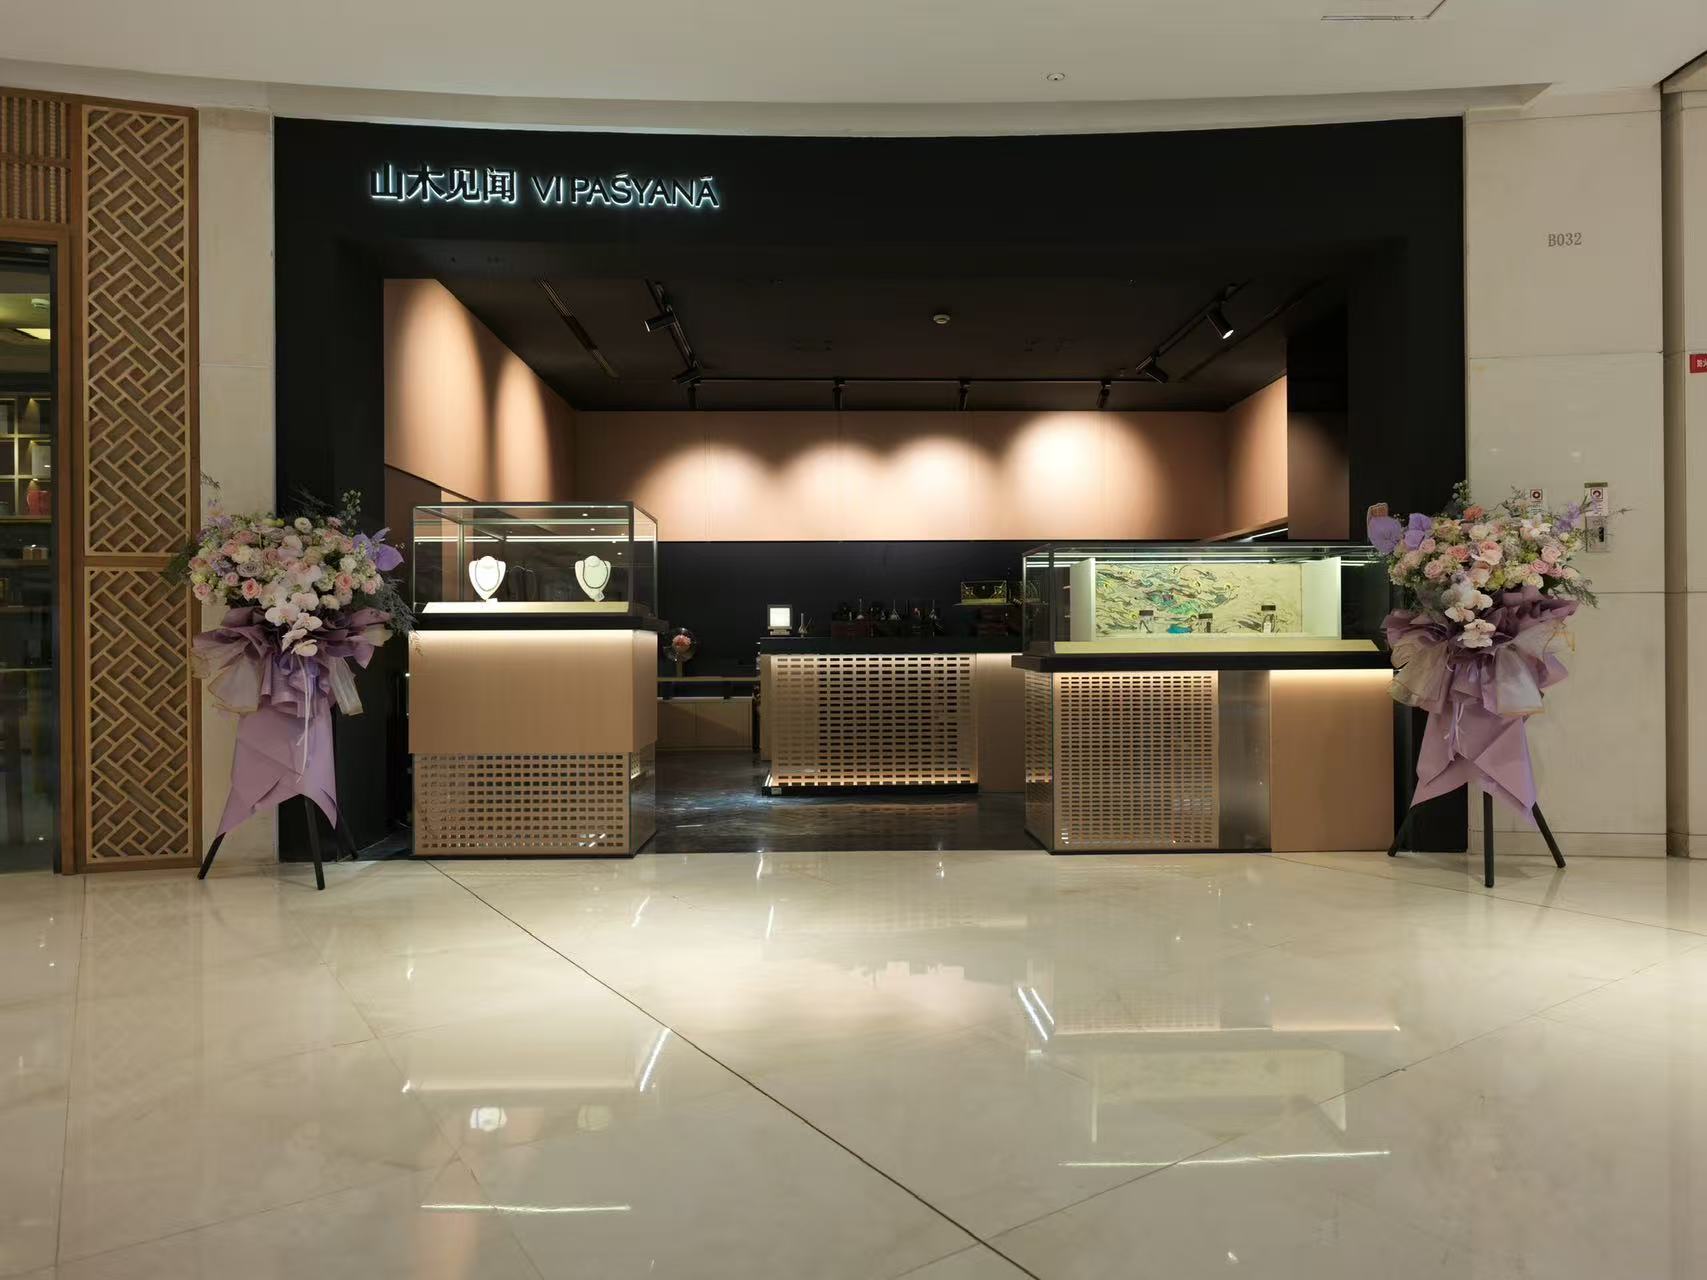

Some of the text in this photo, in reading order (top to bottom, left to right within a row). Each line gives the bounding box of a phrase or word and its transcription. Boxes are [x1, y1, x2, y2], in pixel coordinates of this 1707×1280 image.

[370, 161, 516, 203] 山木见闻
[531, 175, 563, 204] VI
[1548, 232, 1582, 247] B032
